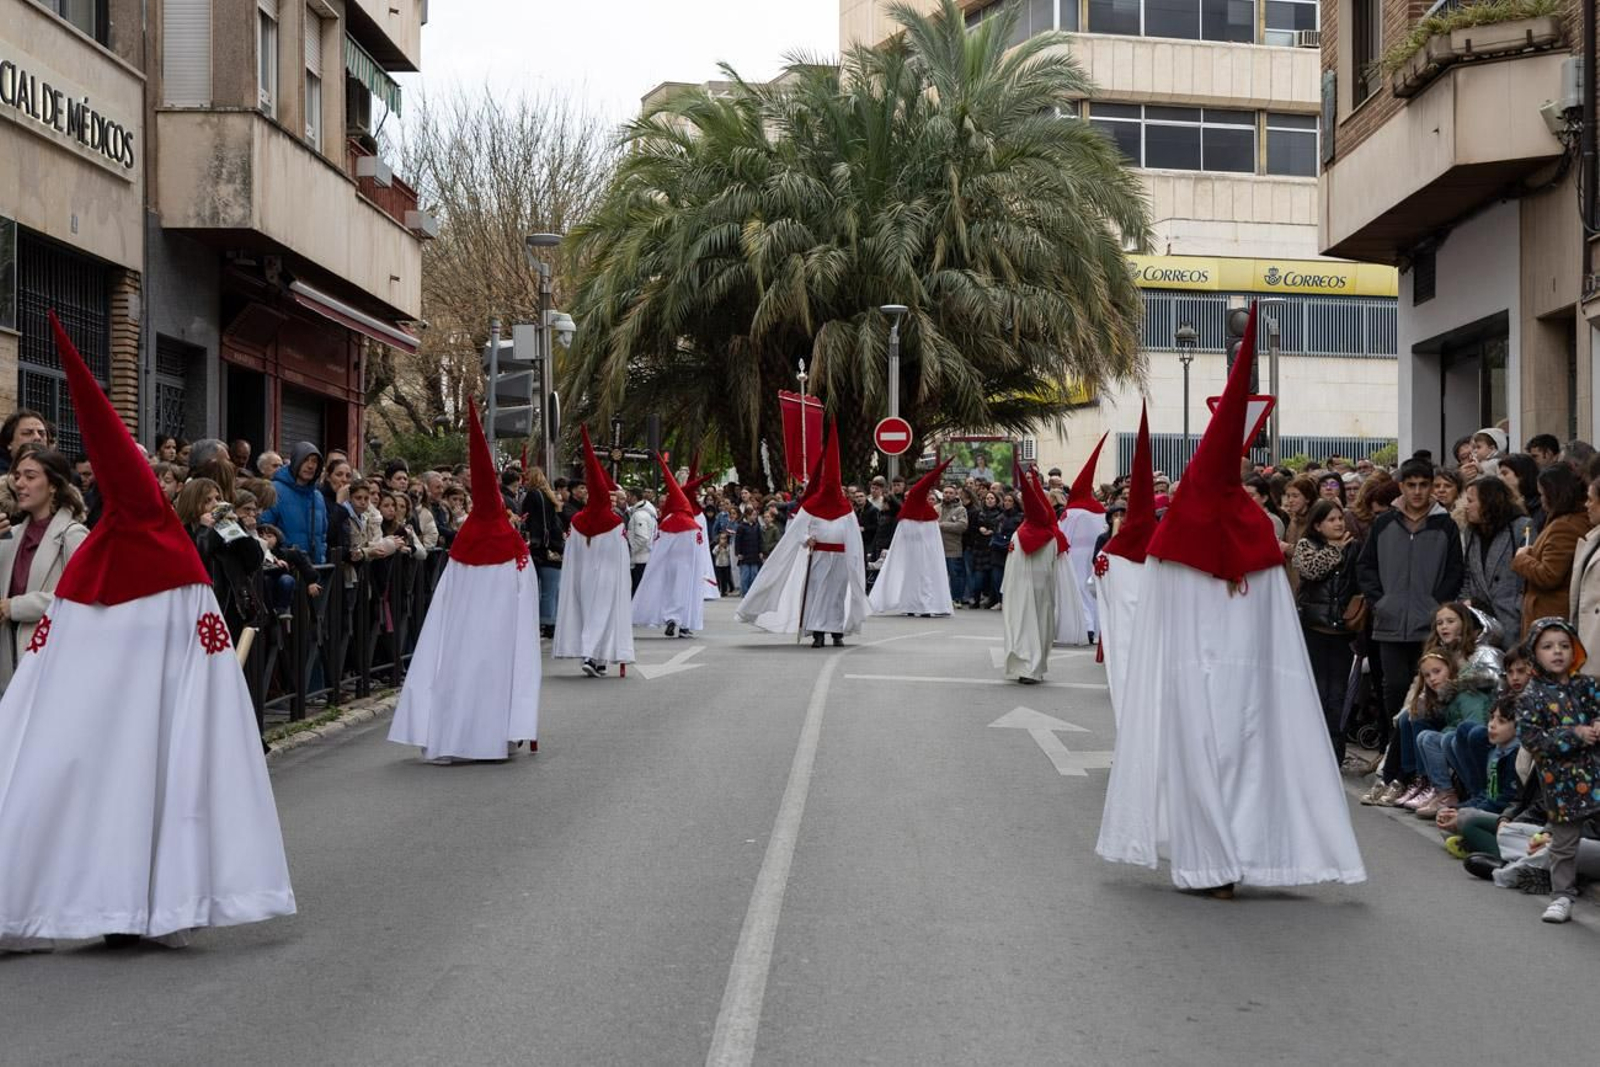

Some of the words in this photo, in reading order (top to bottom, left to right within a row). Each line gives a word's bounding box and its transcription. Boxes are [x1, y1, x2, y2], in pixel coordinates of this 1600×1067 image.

[42, 82, 64, 132] DE
[66, 96, 134, 169] MÉDICOS
[1142, 265, 1209, 283] CORREOS
[1283, 271, 1347, 289] CORREOS
